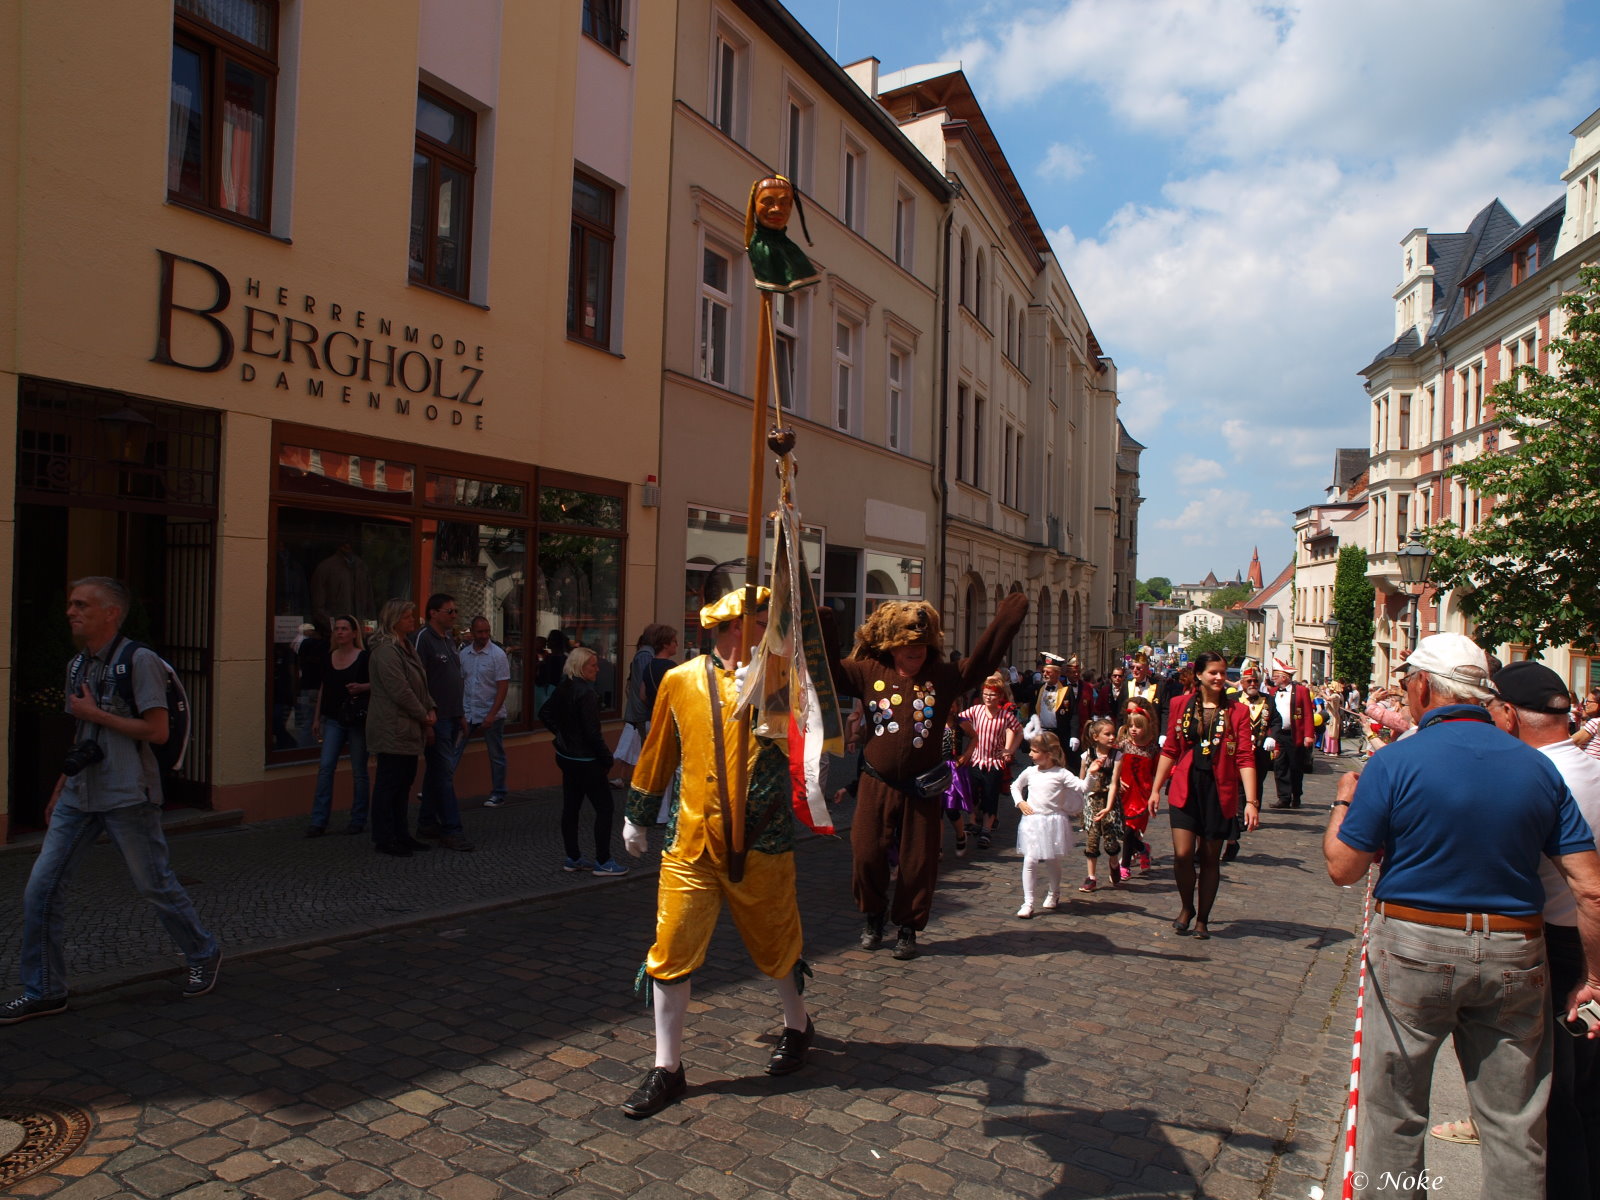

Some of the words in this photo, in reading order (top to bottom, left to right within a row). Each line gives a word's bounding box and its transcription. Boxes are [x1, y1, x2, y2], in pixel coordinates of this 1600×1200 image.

[149, 248, 484, 406] BERGHOLZ
[248, 277, 484, 361] HERRENMODE
[241, 363, 484, 430] DAMENMODE
